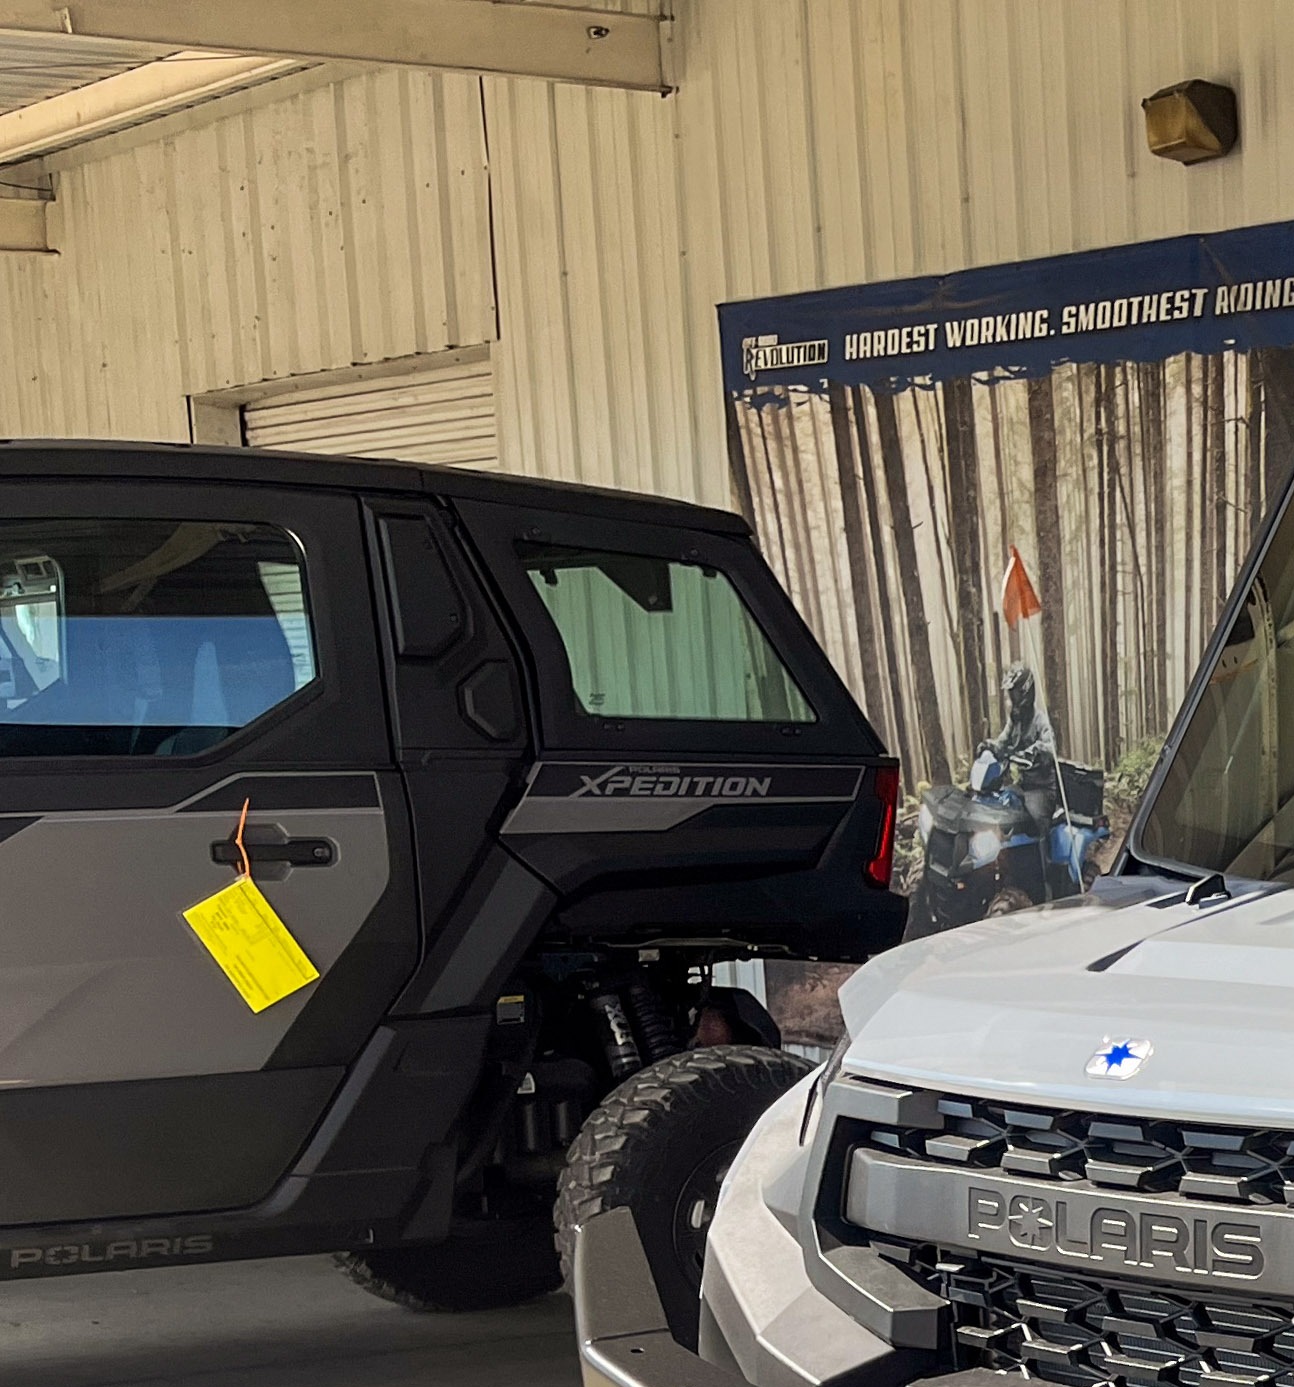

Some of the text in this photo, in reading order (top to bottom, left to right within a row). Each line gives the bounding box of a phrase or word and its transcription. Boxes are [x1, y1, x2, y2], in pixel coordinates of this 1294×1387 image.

[844, 323, 938, 361] HARDEST
[944, 309, 1055, 348] WORKING.
[1061, 287, 1208, 335] SMOOTHEST
[743, 339, 828, 379] REVOLUTION
[567, 765, 772, 799] XPEDITION
[11, 1234, 213, 1269] POLARIS
[968, 1186, 1265, 1280] POLARIS
